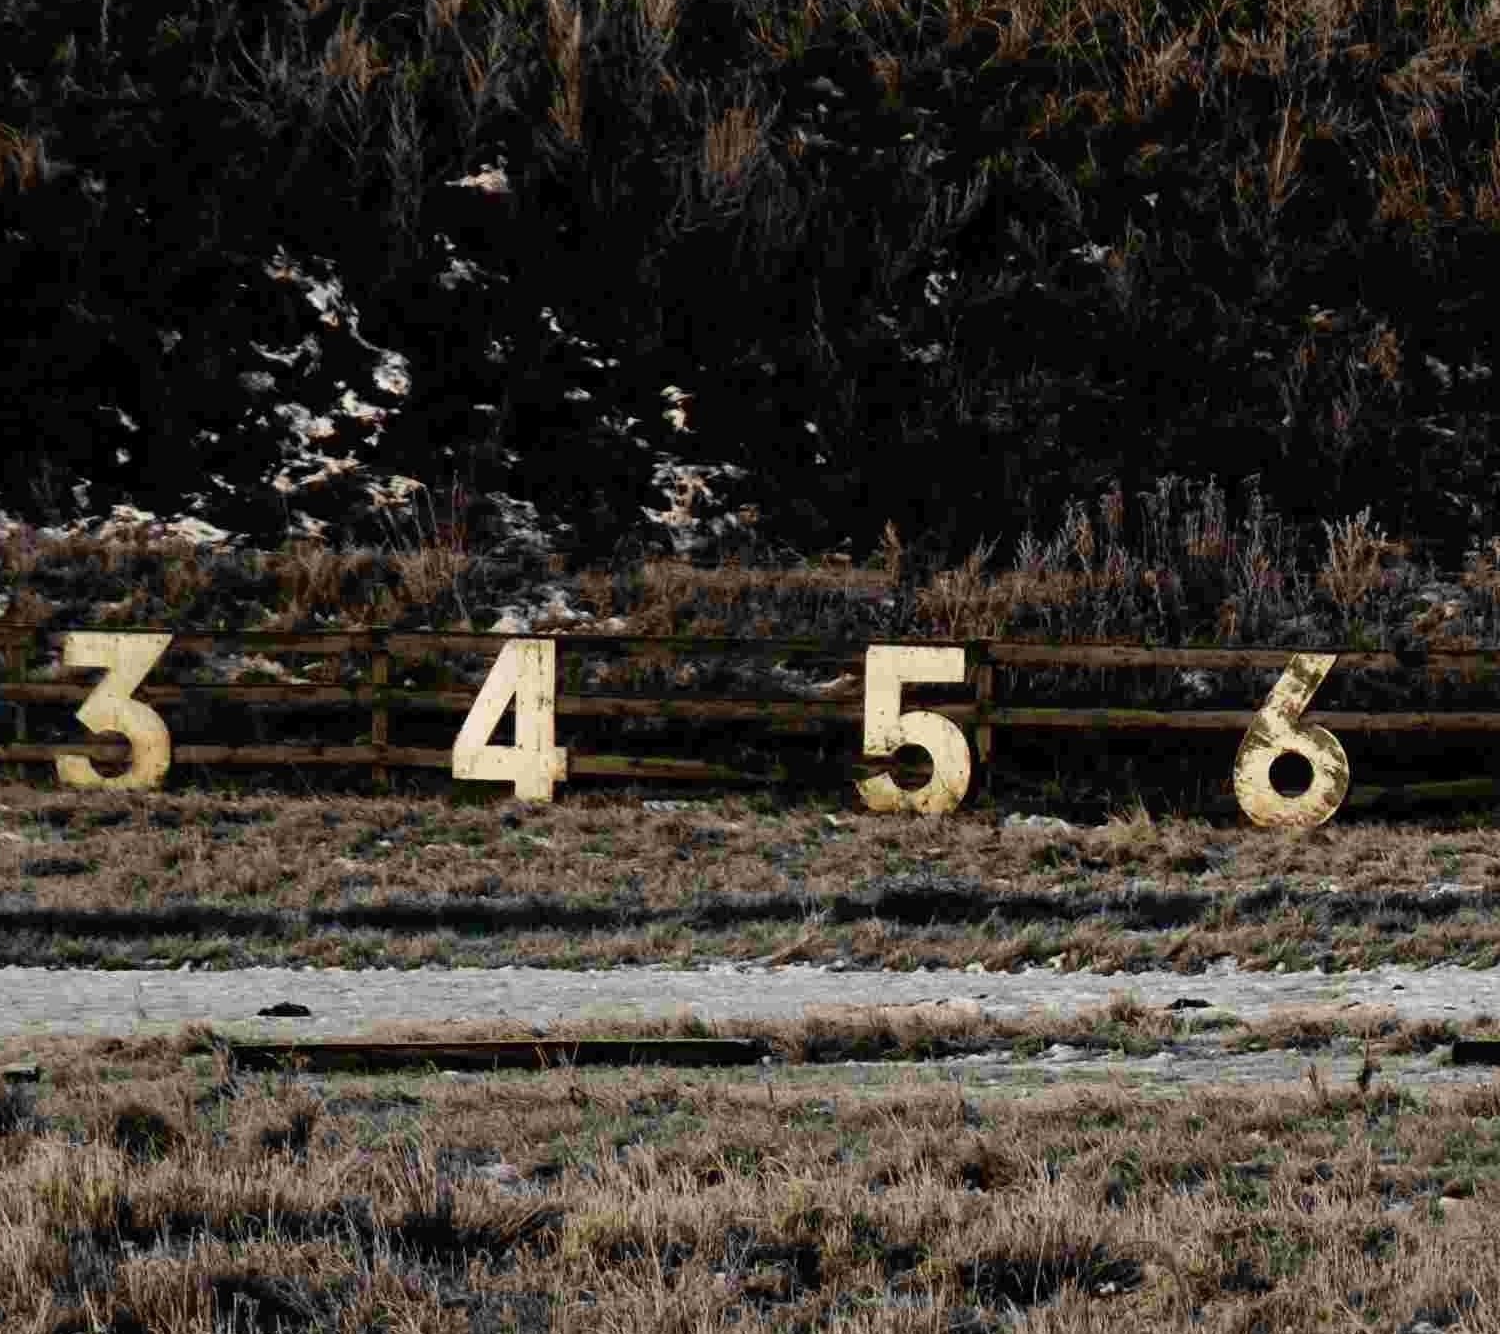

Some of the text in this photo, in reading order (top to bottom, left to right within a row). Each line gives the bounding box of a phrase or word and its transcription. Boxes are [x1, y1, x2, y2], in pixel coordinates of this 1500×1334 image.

[55, 631, 172, 790] 3
[452, 638, 568, 803] 4
[856, 645, 972, 814] 5
[1234, 653, 1351, 827] 6
